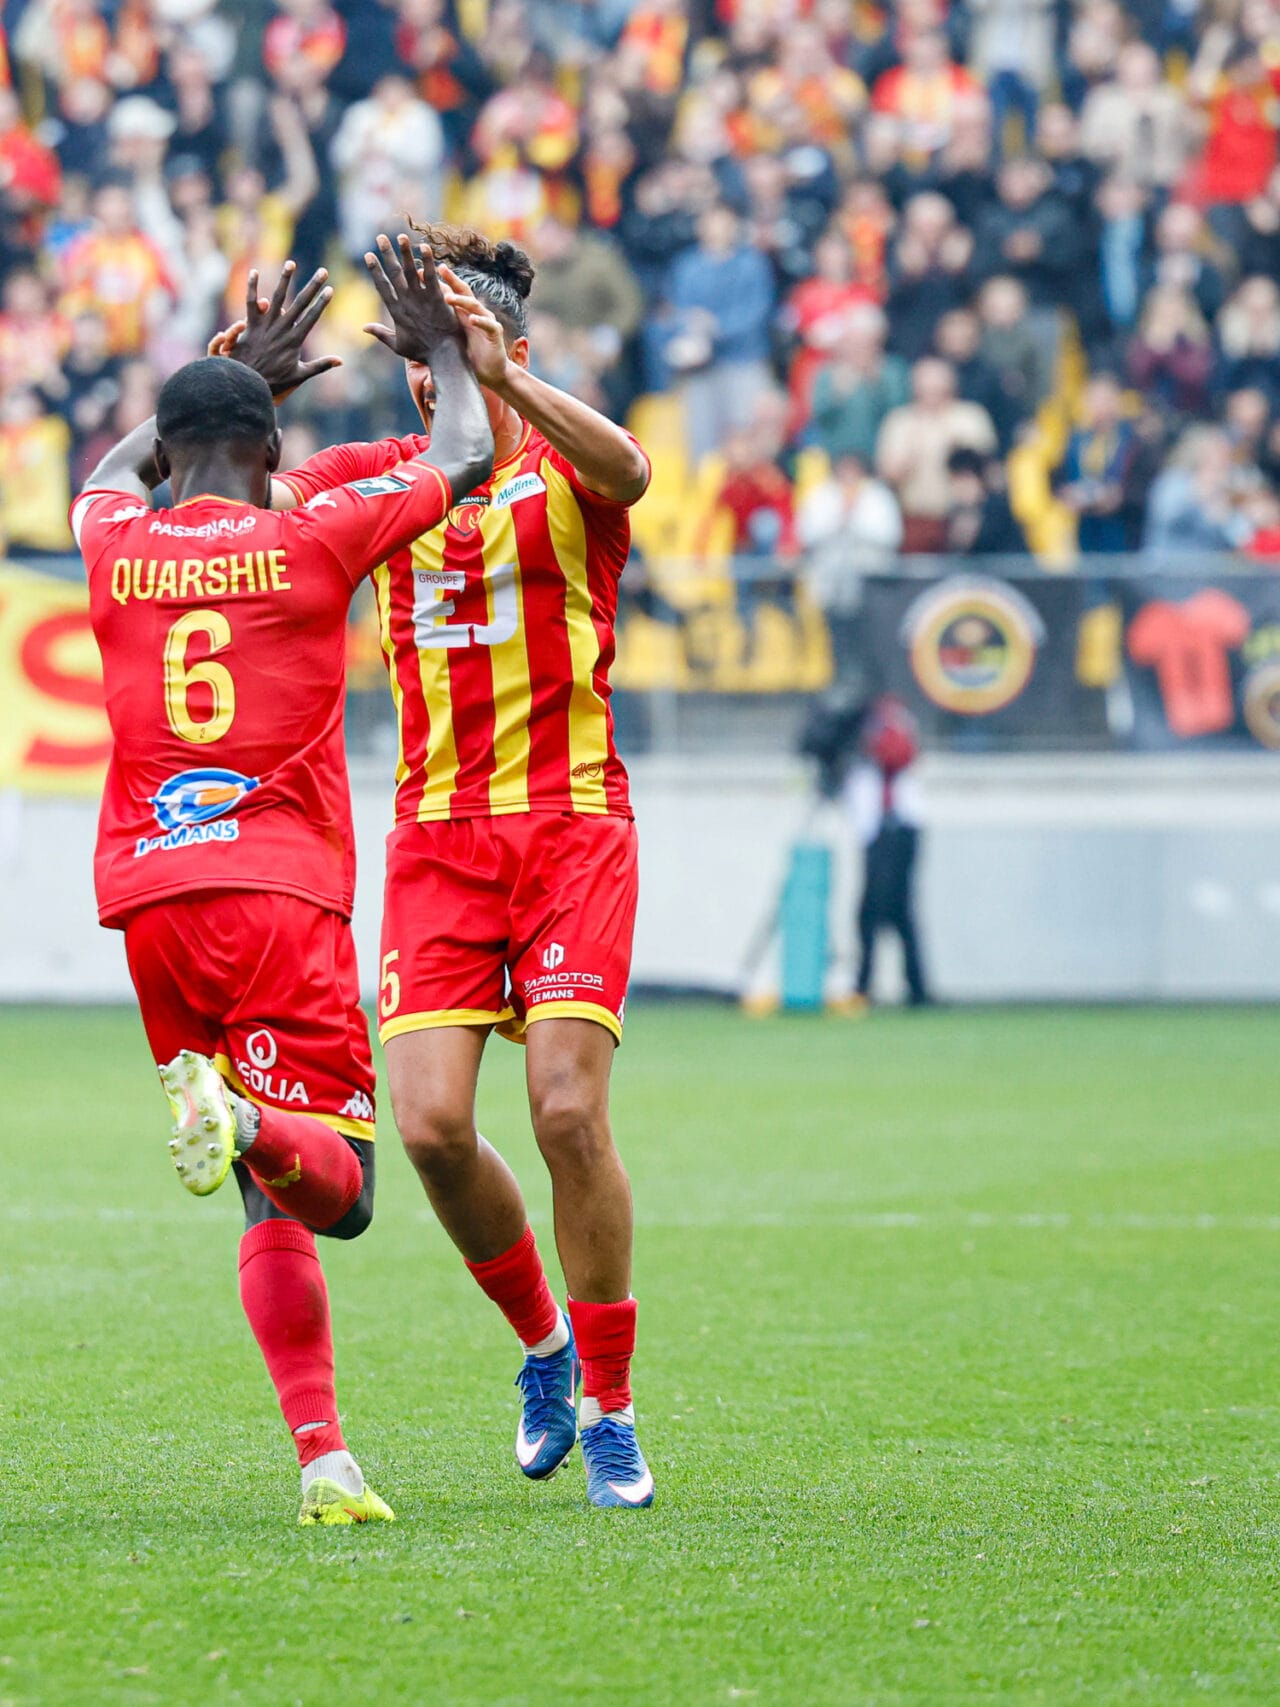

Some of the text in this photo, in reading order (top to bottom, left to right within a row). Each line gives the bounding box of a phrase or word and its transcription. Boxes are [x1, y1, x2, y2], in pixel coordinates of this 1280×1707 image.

[148, 515, 257, 538] PASSENAUD
[111, 549, 292, 605] QUARSHIE
[418, 573, 458, 586] GROUPE
[164, 609, 236, 745] 6
[163, 819, 239, 848] MANS
[381, 949, 401, 1018] 5
[532, 989, 574, 1004] LE MANS
